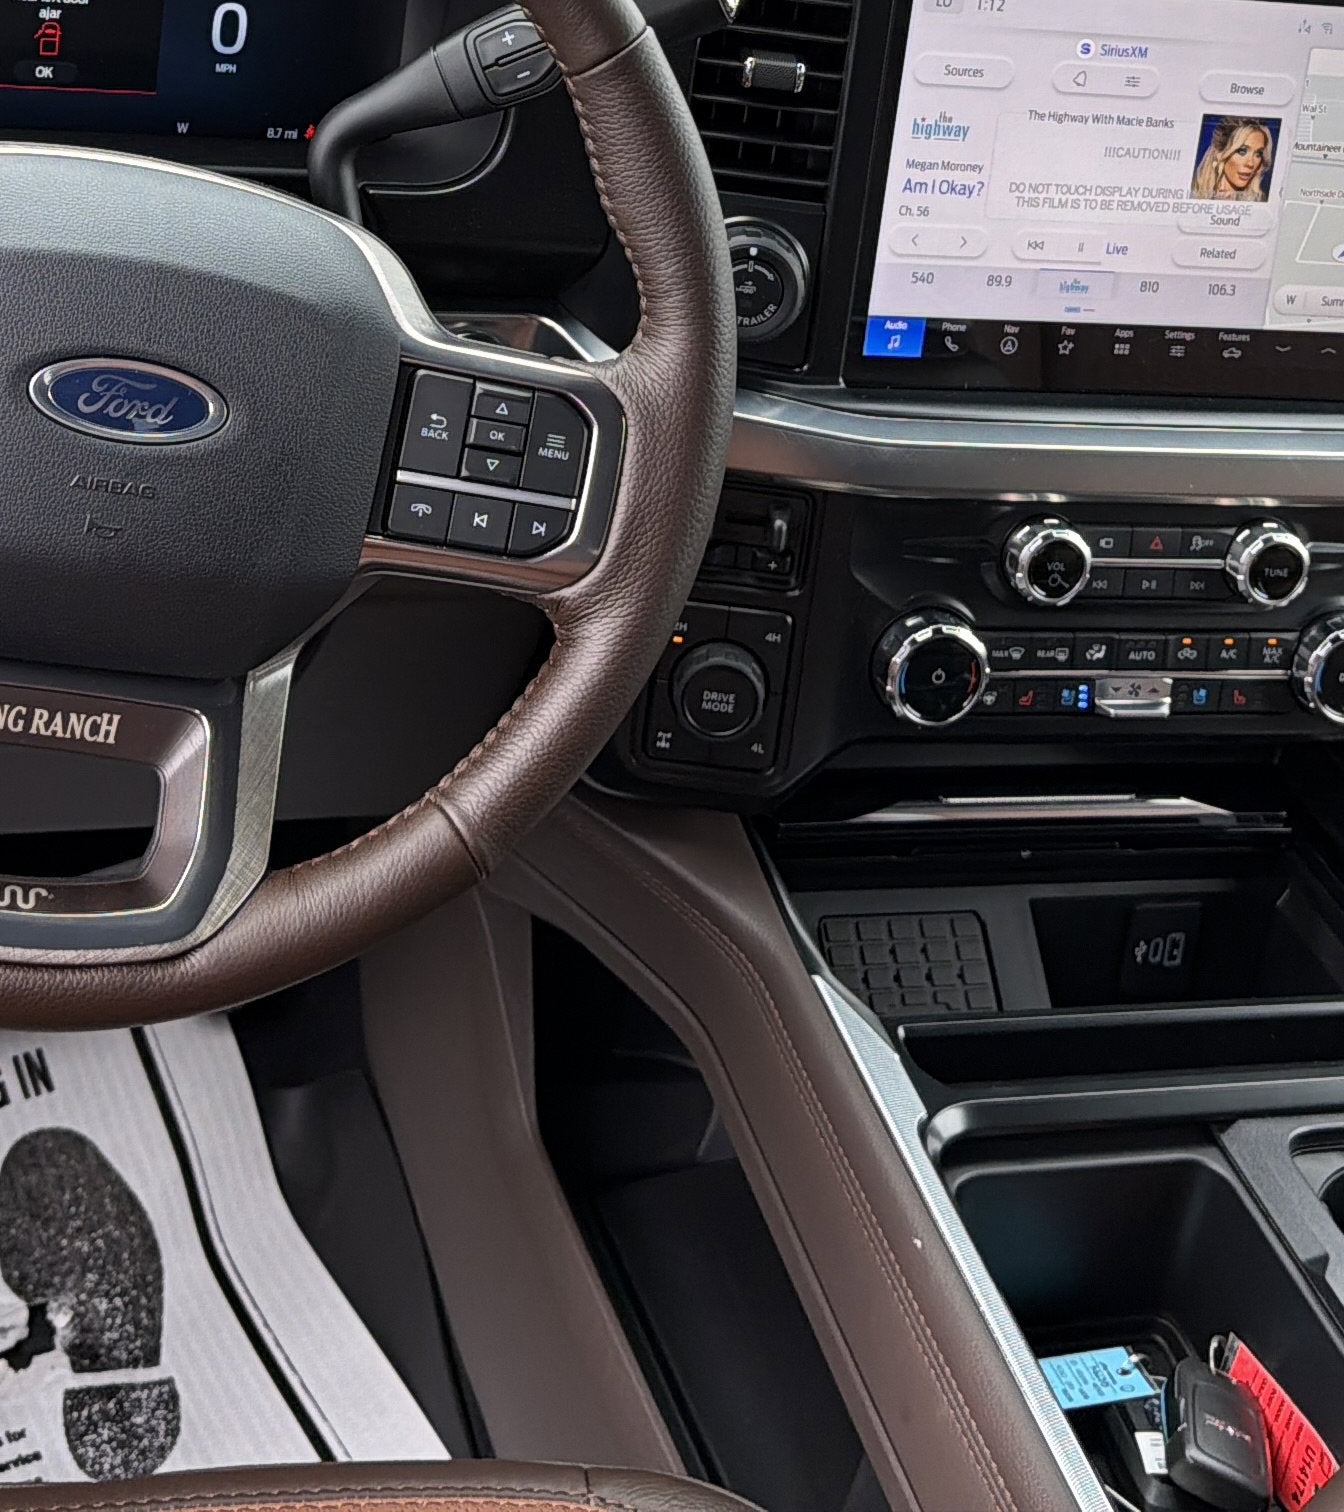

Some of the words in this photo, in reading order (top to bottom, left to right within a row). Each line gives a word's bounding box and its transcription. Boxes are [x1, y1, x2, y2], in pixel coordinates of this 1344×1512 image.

[39, 6, 62, 20] ajar
[212, 2, 248, 55] 0
[1100, 44, 1149, 59] SiriusXM
[35, 66, 54, 78] OK
[215, 63, 237, 74] MPH
[944, 65, 984, 79] Sources
[1230, 83, 1265, 96] Browse
[939, 111, 953, 124] the
[1028, 109, 1046, 121] The
[1048, 111, 1090, 125] Highway
[1091, 113, 1114, 125] With
[1116, 115, 1144, 127] Macie
[1145, 117, 1175, 129] Banks
[177, 122, 189, 134] W
[266, 128, 282, 139] 8.7
[284, 128, 298, 139] mi
[912, 118, 970, 142] highway
[906, 158, 939, 172] Megan
[941, 160, 984, 174] Moroney
[902, 178, 928, 194] Am
[931, 179, 936, 194] I
[938, 179, 985, 199] Okay?
[1009, 182, 1026, 194] DO
[1028, 182, 1052, 194] NOT
[1054, 183, 1093, 196] TOUCH
[1094, 185, 1141, 198] DISPLAY
[1142, 187, 1184, 200] DURING
[898, 205, 914, 217] Ch.
[916, 206, 930, 217] 56
[1015, 196, 1040, 208] THIS
[1042, 197, 1068, 209] FILM
[1070, 198, 1081, 210] IS
[1083, 198, 1098, 210] TO
[1099, 199, 1114, 211] BE
[1116, 200, 1170, 213] REMOVED
[1172, 202, 1214, 215] BEFORE
[1210, 215, 1241, 227] Sound
[1106, 242, 1128, 256] Live
[1200, 247, 1236, 260] Related
[911, 271, 934, 285] 540
[986, 274, 1012, 288] 89.9
[1139, 280, 1159, 294] 810
[1207, 283, 1236, 297] 106.3
[1285, 294, 1296, 306] W
[737, 303, 778, 326] TRAILER
[884, 320, 908, 331] Audio
[941, 322, 967, 333] Phone
[1004, 324, 1019, 334] Nav
[1061, 327, 1075, 337] Fav
[1114, 328, 1134, 339] Apps
[1164, 330, 1195, 342] Settings
[1218, 332, 1250, 342] Features
[77, 374, 177, 425] Ford
[420, 427, 449, 441] BACK
[489, 431, 505, 441] OK
[538, 447, 570, 461] MENU
[69, 474, 156, 499] AIRBAG
[1047, 562, 1065, 572] VOL
[1264, 567, 1288, 578] TUNE
[764, 632, 782, 643] 4H
[1129, 651, 1155, 661] AUTO
[1220, 649, 1237, 660] A/C
[1263, 648, 1283, 657] MAX
[1264, 656, 1281, 665] A/C
[702, 690, 736, 703] DRIVE
[701, 700, 735, 713] MODE
[29, 707, 122, 744] RANCH
[751, 743, 764, 754] 4L
[11, 1048, 56, 1100] IN
[5, 1428, 26, 1443] for
